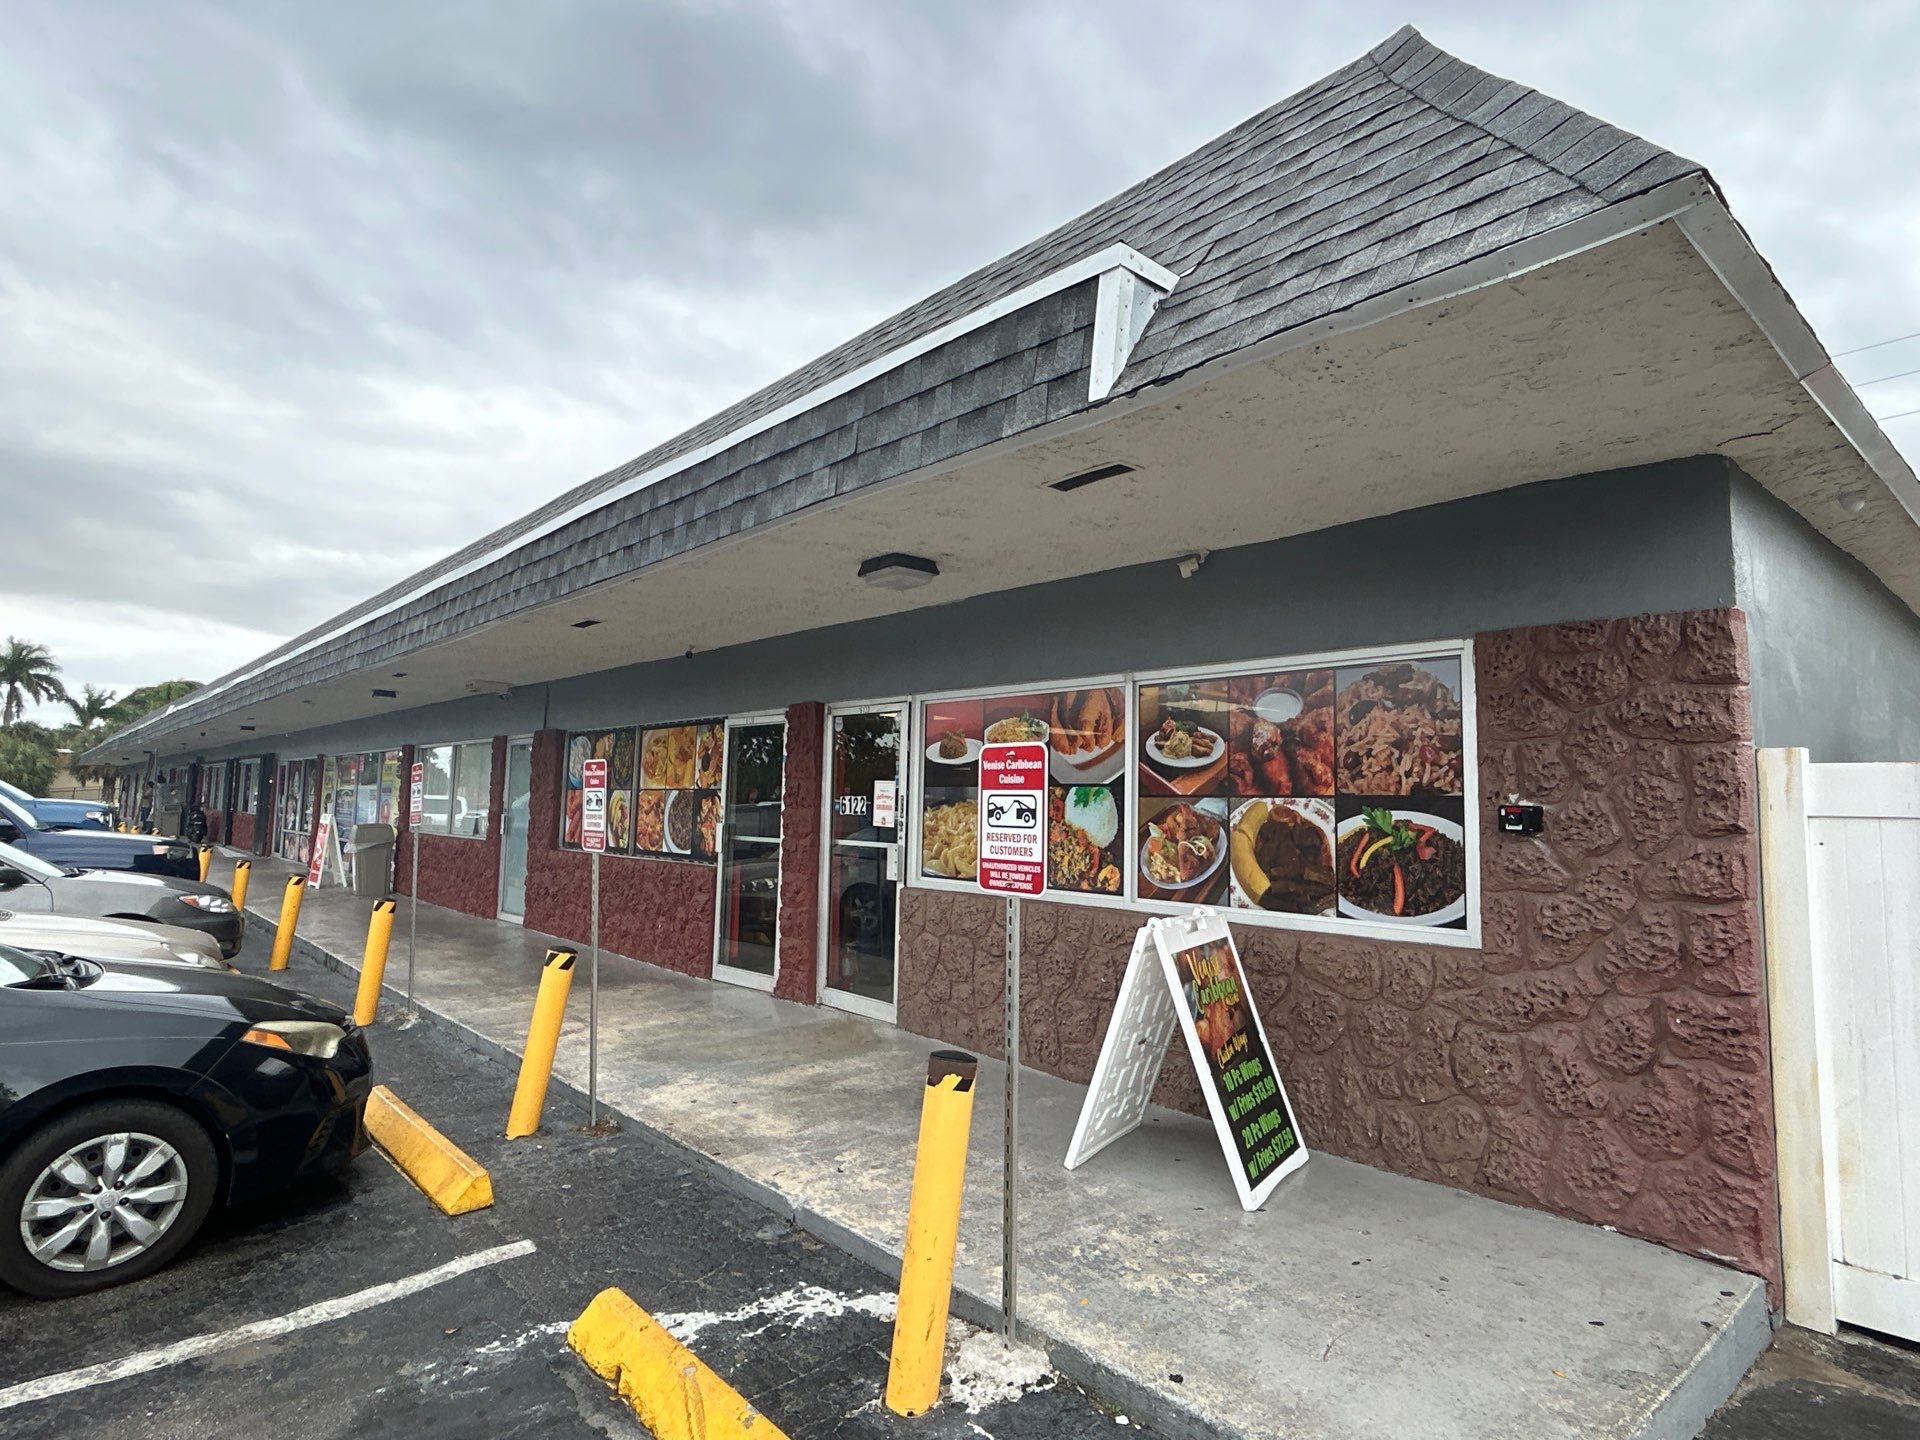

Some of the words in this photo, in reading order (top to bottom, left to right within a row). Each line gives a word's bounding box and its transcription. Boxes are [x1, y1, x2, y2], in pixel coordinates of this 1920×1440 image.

[983, 760, 1005, 770] Venise
[1006, 759, 1043, 770] Caribbean
[999, 773, 1025, 784] Cuisine
[841, 797, 865, 814] 6122
[986, 832, 1022, 843] RESERVED
[1023, 834, 1038, 844] FOR
[990, 845, 1034, 857] CUSTOMERS
[1018, 864, 1042, 873] VEHICLES
[990, 871, 1001, 879] WILL
[1026, 874, 1033, 882] AT
[1223, 1071, 1235, 1092] 10
[1230, 1068, 1243, 1087] Pc
[1239, 1057, 1263, 1081] Wings
[1236, 1091, 1256, 1115] Fries
[1242, 1126, 1254, 1149] 20
[1250, 1122, 1263, 1142] Pc
[1258, 1108, 1282, 1135] Wings
[1255, 1146, 1276, 1171] Fries
